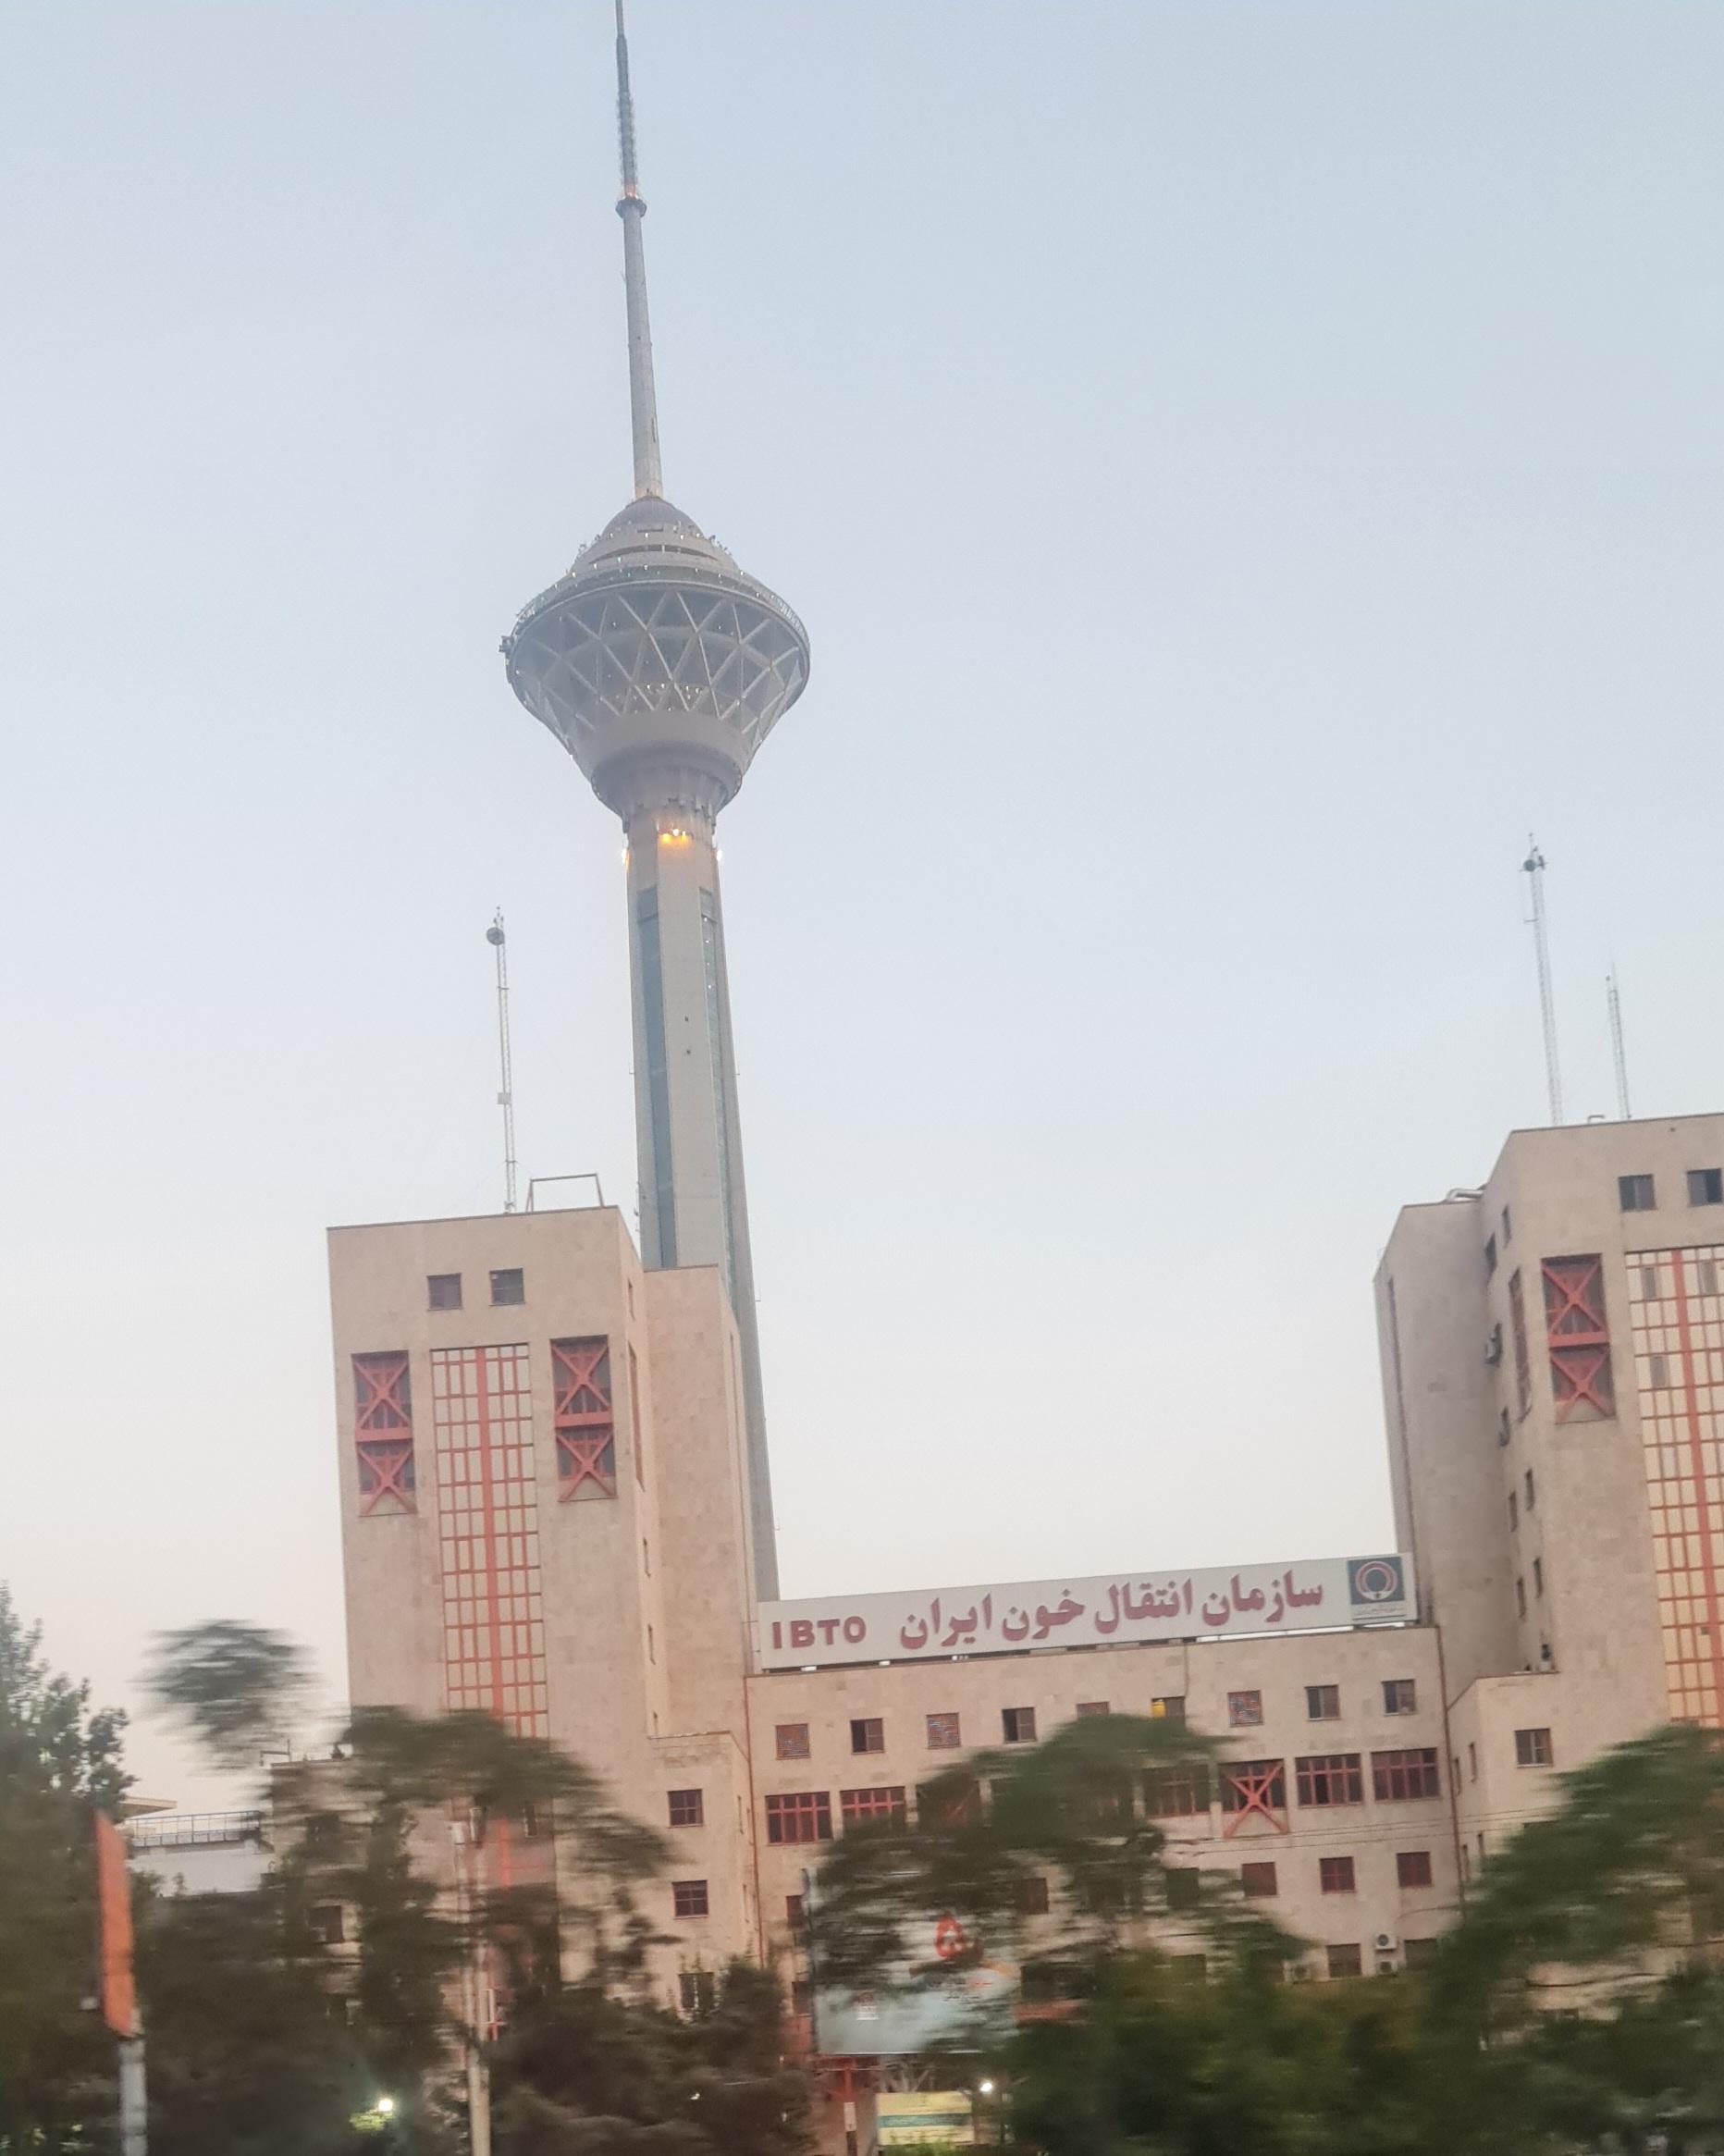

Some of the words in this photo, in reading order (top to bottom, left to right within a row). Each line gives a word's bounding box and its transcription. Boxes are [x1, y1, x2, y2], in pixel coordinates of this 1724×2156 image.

[901, 1595, 992, 1648] ایران
[1003, 1589, 1085, 1641] خون
[1095, 1579, 1192, 1632] انتقال
[1202, 1571, 1323, 1625] سازمان
[772, 1616, 866, 1649] IBTO
